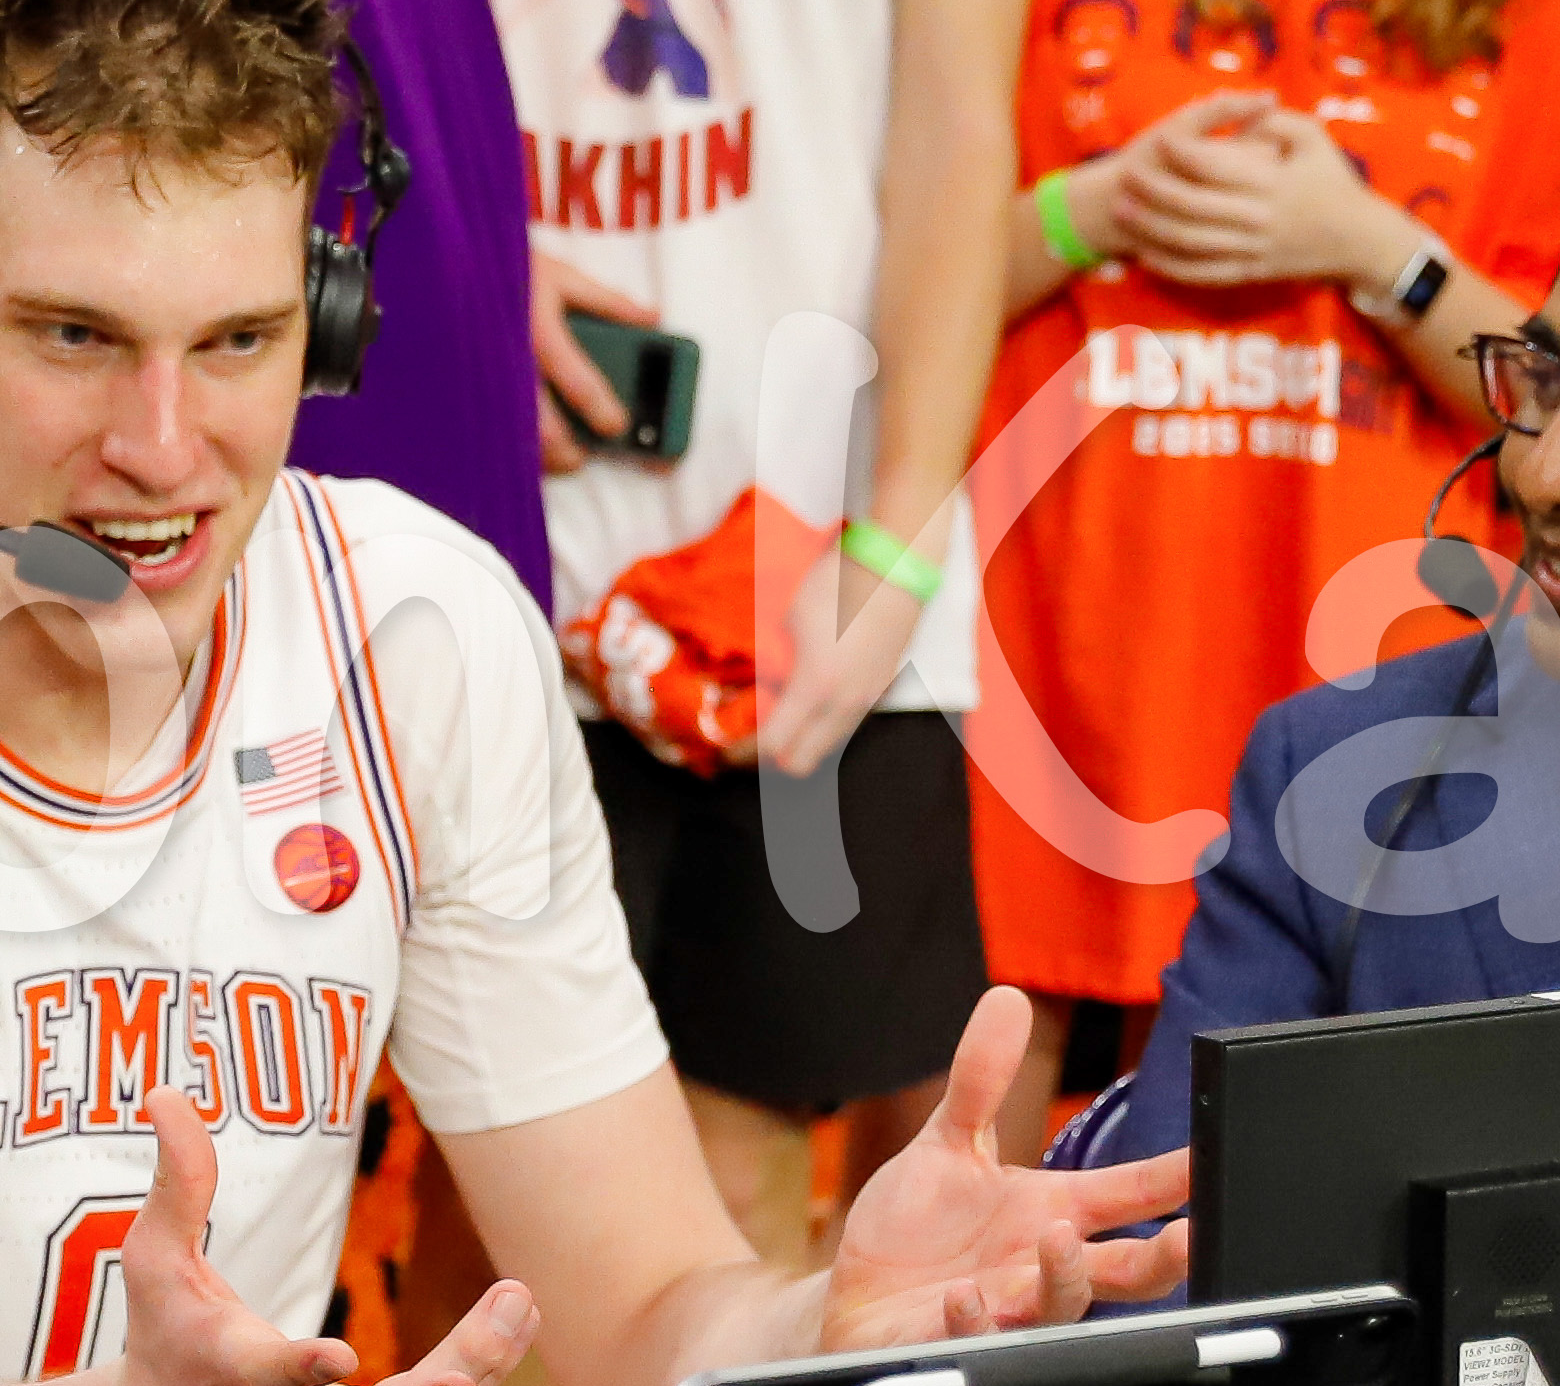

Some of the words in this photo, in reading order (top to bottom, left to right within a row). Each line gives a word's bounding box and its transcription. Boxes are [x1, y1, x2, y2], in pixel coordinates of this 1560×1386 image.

[1493, 1354, 1526, 1368] MODEL
[1463, 1371, 1490, 1384] Power
[1491, 1367, 1521, 1381] Supply
